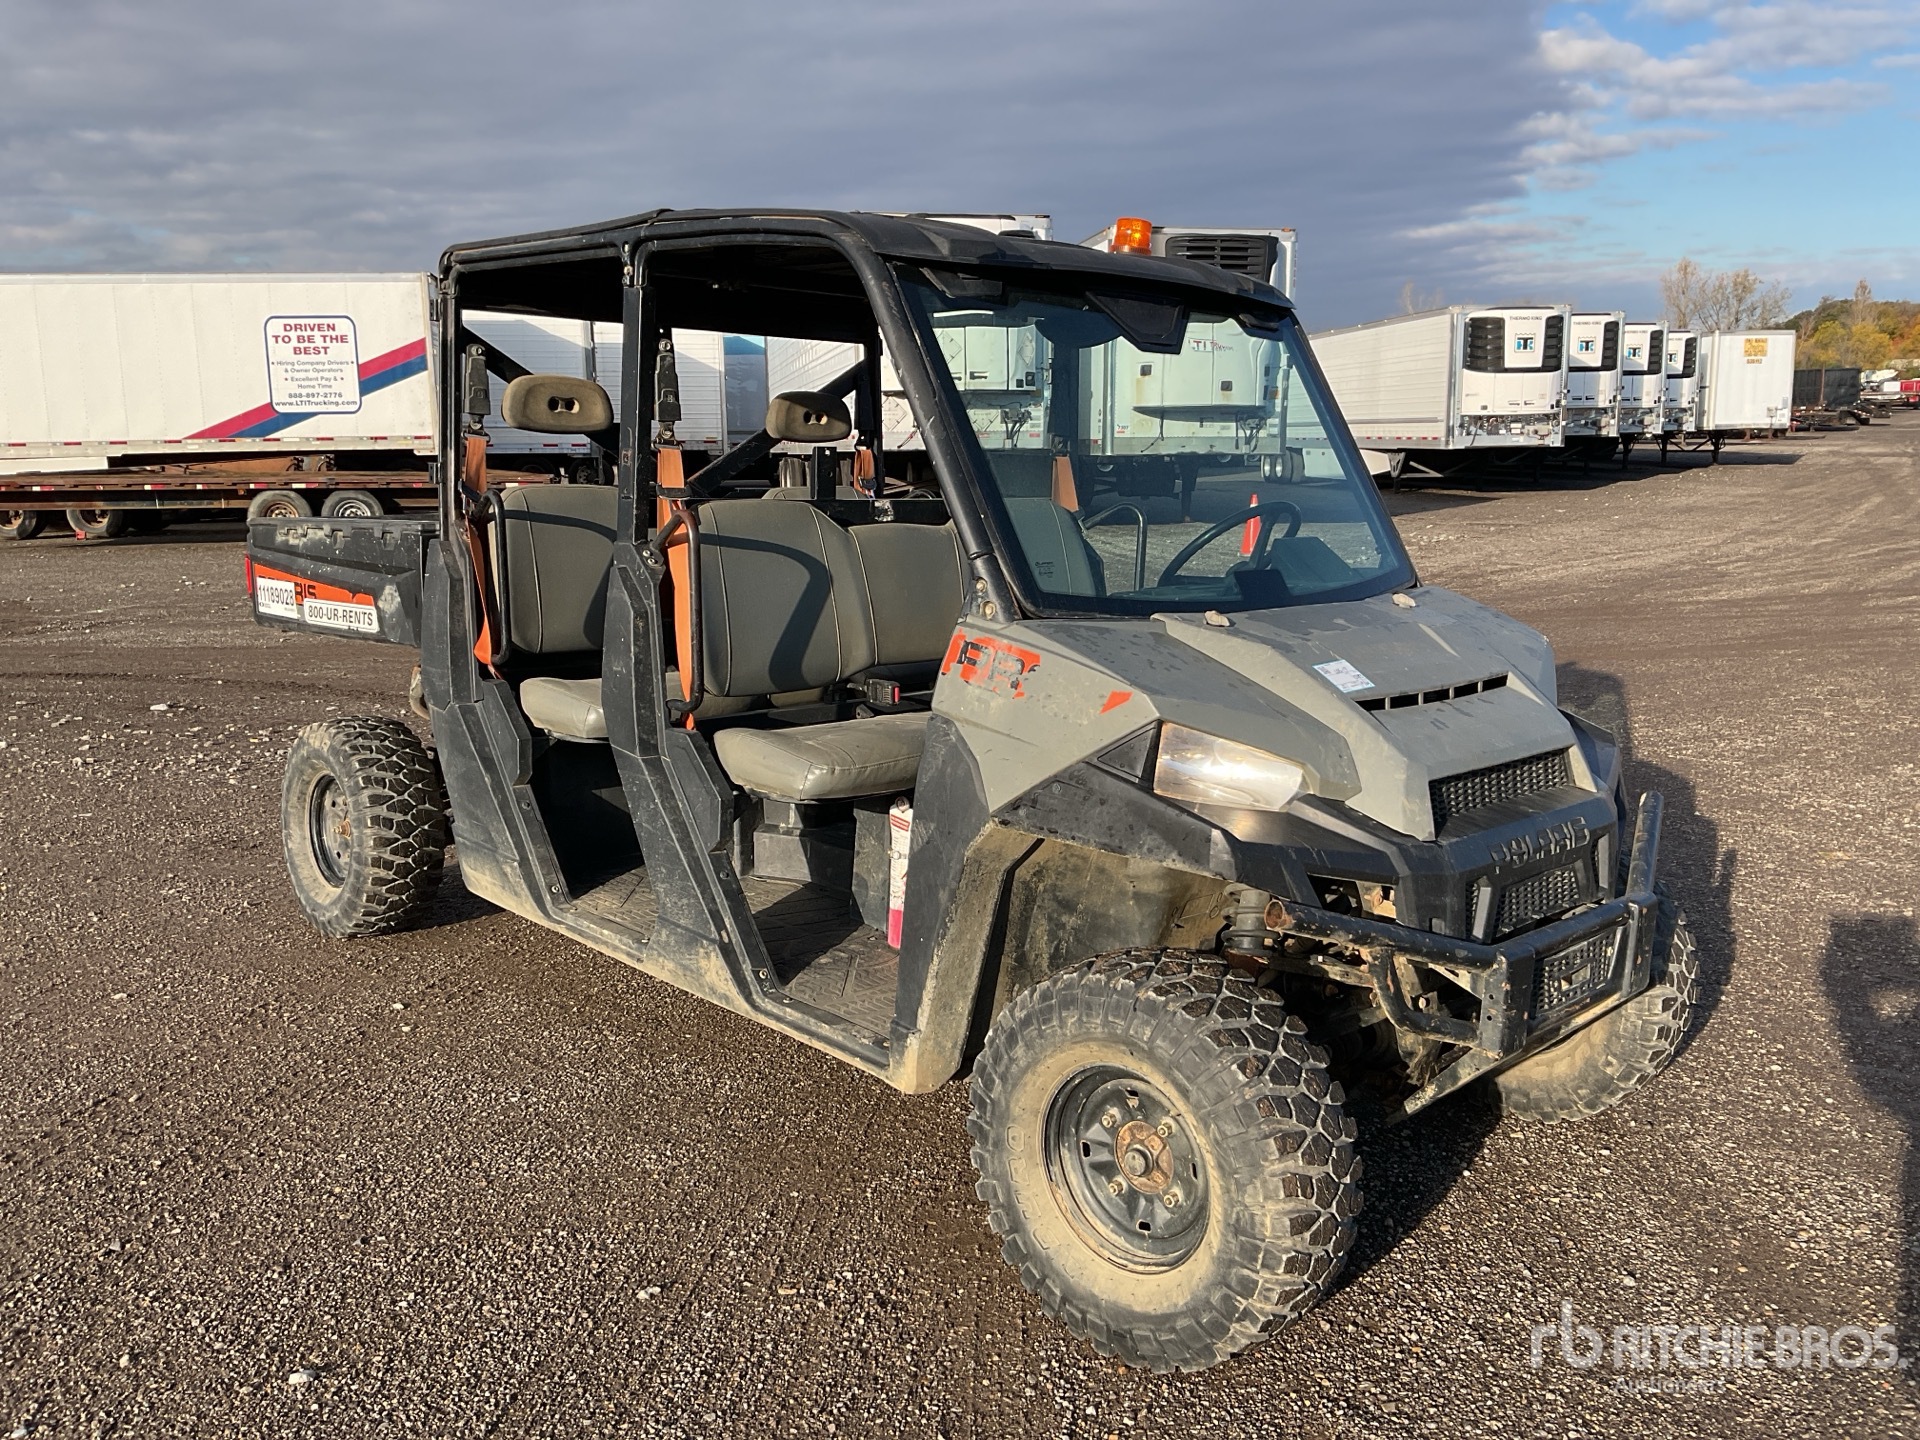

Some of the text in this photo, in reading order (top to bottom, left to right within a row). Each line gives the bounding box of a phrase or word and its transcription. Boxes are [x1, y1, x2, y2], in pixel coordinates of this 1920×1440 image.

[283, 323, 336, 332] DRIVEN
[272, 334, 349, 344] TO BE THE
[293, 346, 330, 355] BEST
[258, 585, 295, 606] 11189028
[308, 605, 373, 627] 800-UR-RENTS
